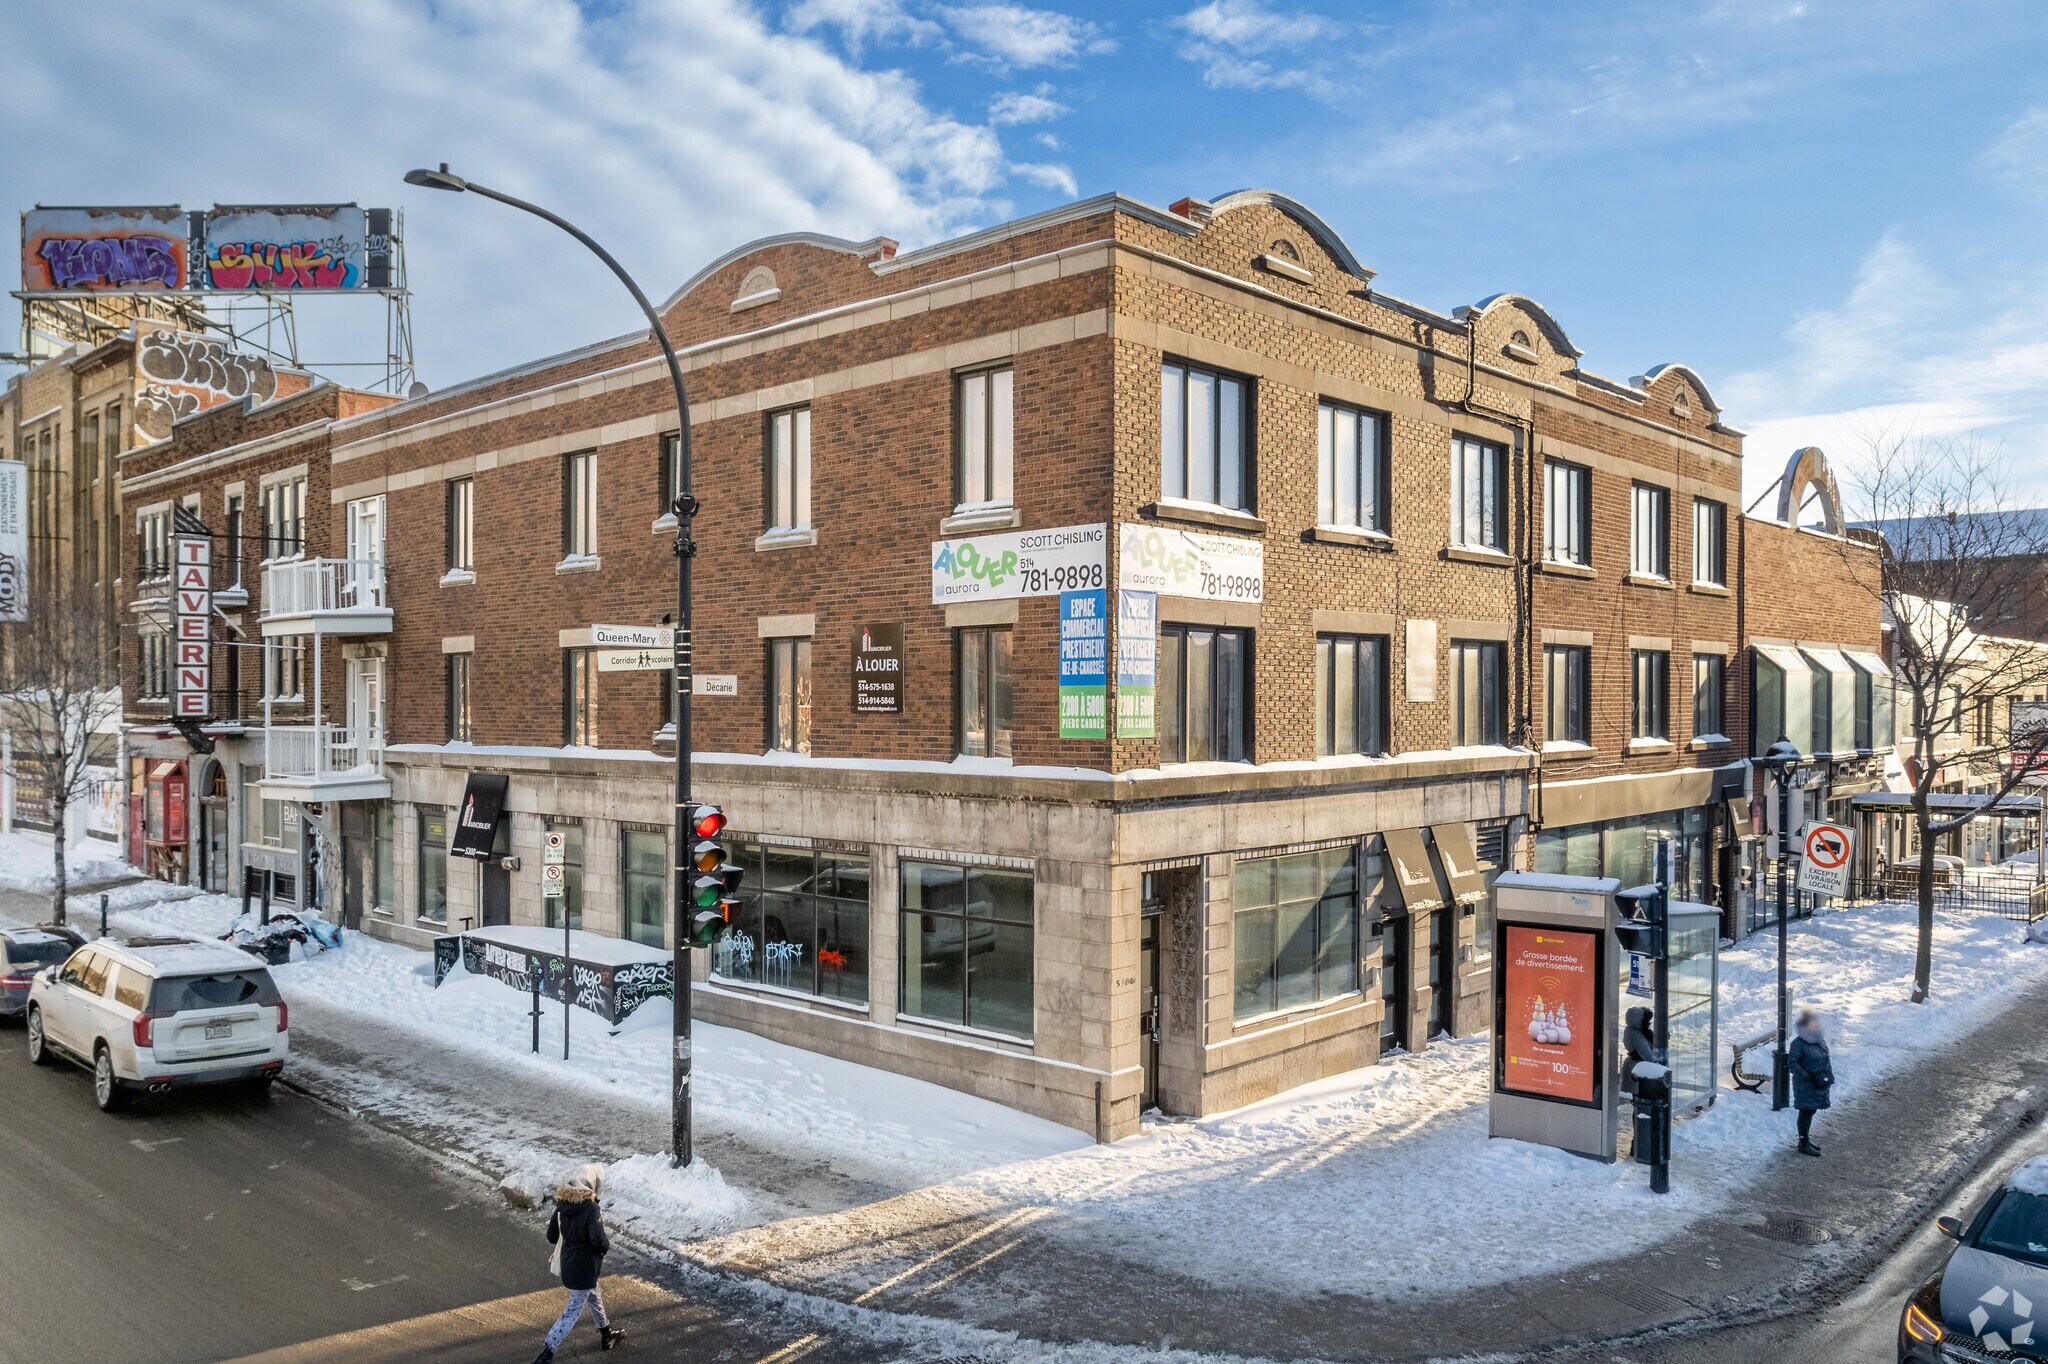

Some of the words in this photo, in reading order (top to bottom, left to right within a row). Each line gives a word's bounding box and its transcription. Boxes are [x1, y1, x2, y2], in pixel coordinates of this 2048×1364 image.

[10, 522, 18, 534] ET
[1020, 535, 1052, 549] SCOTT
[1054, 530, 1103, 546] CHISLING
[1200, 540, 1226, 553] SCOTT
[1226, 543, 1261, 558] CHISLING
[1020, 558, 1035, 569] 514
[1200, 560, 1212, 571] 514
[1020, 563, 1103, 593] 781-9898
[1132, 573, 1166, 586] aurora
[946, 583, 980, 595] aurora
[1200, 572, 1261, 599] 781-9898
[1070, 598, 1096, 618] ESPACE
[181, 543, 206, 714] TAVERNE
[1061, 618, 1105, 639] COMMERCIAL
[597, 632, 657, 646] Queen-Mary
[1061, 639, 1105, 659] PRESTIGIEUX
[611, 657, 637, 665] Corridor
[651, 655, 674, 663] scolaire
[856, 656, 864, 672] À
[865, 659, 899, 672] LOUER
[706, 682, 733, 693] Décarie
[1061, 695, 1079, 717] 2300
[1080, 692, 1086, 716] À
[1086, 695, 1105, 717] 5000
[1061, 718, 1080, 729] PIEDS
[1080, 717, 1105, 730] CARRÉS
[1805, 873, 1841, 886] LIVRAISON
[1808, 880, 1834, 891] LOCALE
[1522, 950, 1549, 961] Grosse
[1549, 952, 1578, 964] bordée
[1515, 958, 1526, 966] de
[1526, 959, 1585, 973] divertissement.
[1551, 1062, 1569, 1074] 100
